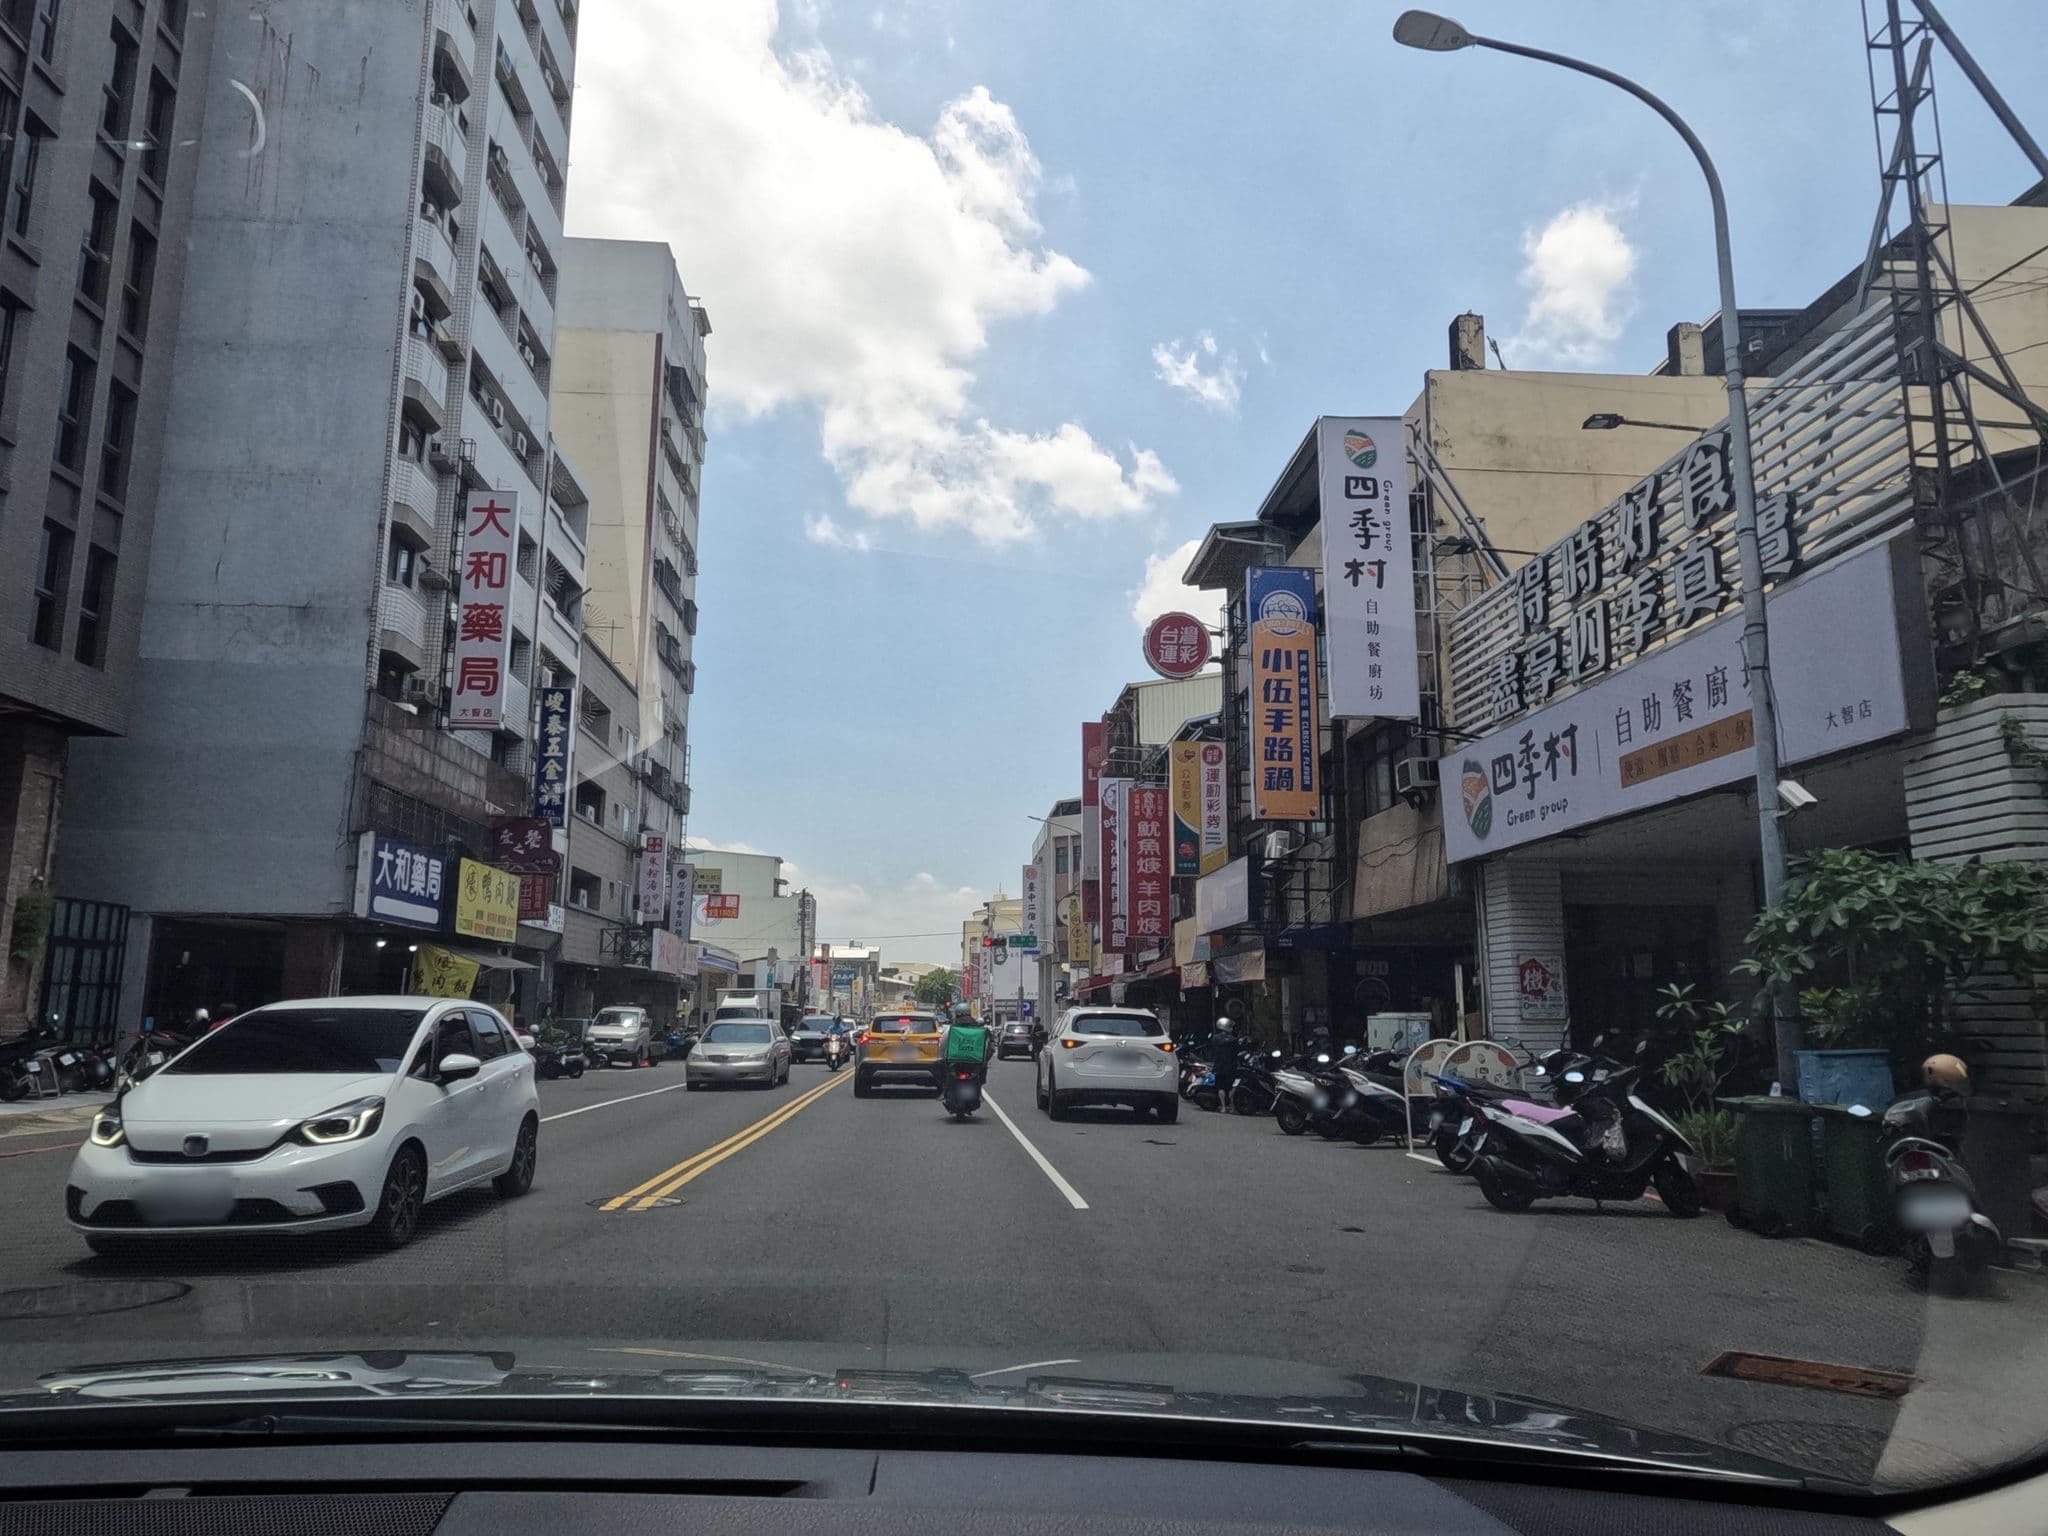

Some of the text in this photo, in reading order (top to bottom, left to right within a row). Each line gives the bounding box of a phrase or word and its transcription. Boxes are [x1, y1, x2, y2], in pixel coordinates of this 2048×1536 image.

[1344, 475, 1387, 589] 四季村
[1383, 520, 1392, 552] group
[456, 499, 511, 697] 大和藥局
[1159, 645, 1199, 664] 運彩
[1160, 625, 1199, 645] 台灣
[1366, 599, 1383, 700] 自助餐廚坊
[1262, 647, 1294, 792] 小伍手路鍋
[1615, 664, 1752, 747] 自助餐廚
[1302, 721, 1312, 785] CLASSIC FLAVOR
[1491, 722, 1578, 800] 四季村
[1205, 768, 1221, 828] 運動彩券
[1506, 797, 1569, 826] Green group
[375, 844, 442, 900] 大和藥局
